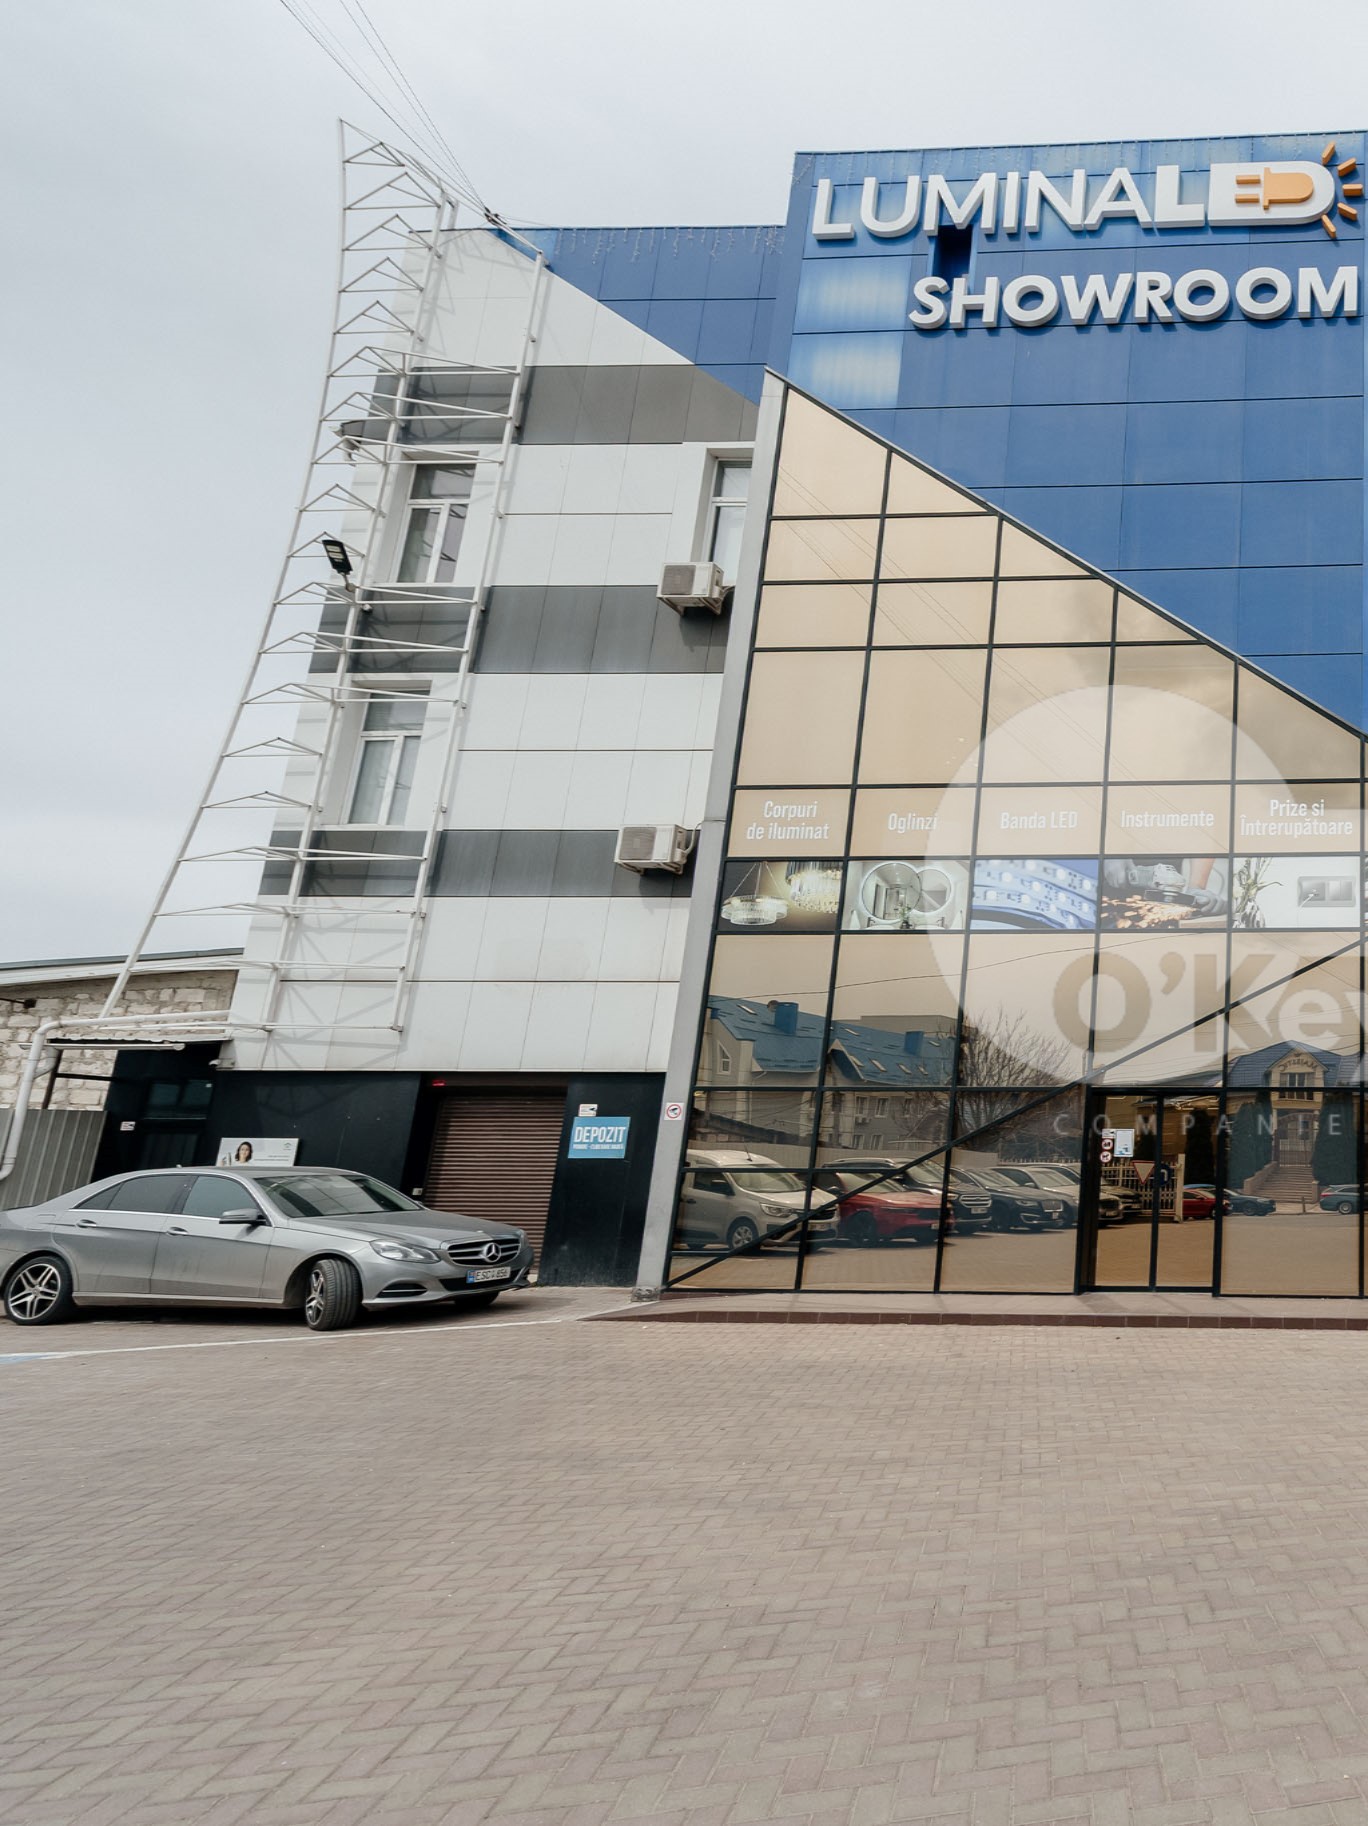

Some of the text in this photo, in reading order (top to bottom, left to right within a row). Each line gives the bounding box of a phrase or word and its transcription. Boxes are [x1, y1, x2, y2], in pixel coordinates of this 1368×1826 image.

[811, 160, 1336, 241] LUMINALED
[908, 265, 1359, 329] SHOWROOM
[763, 801, 817, 820] Corpuri
[1269, 799, 1307, 817] Prize
[887, 812, 939, 834] Oglinzi
[1000, 811, 1078, 830] Banda LED
[1121, 811, 1215, 828] Instrumente
[1240, 814, 1353, 838] Întrerupătoare
[746, 822, 830, 840] de iluminat
[573, 1126, 626, 1143] DEPOZIT
